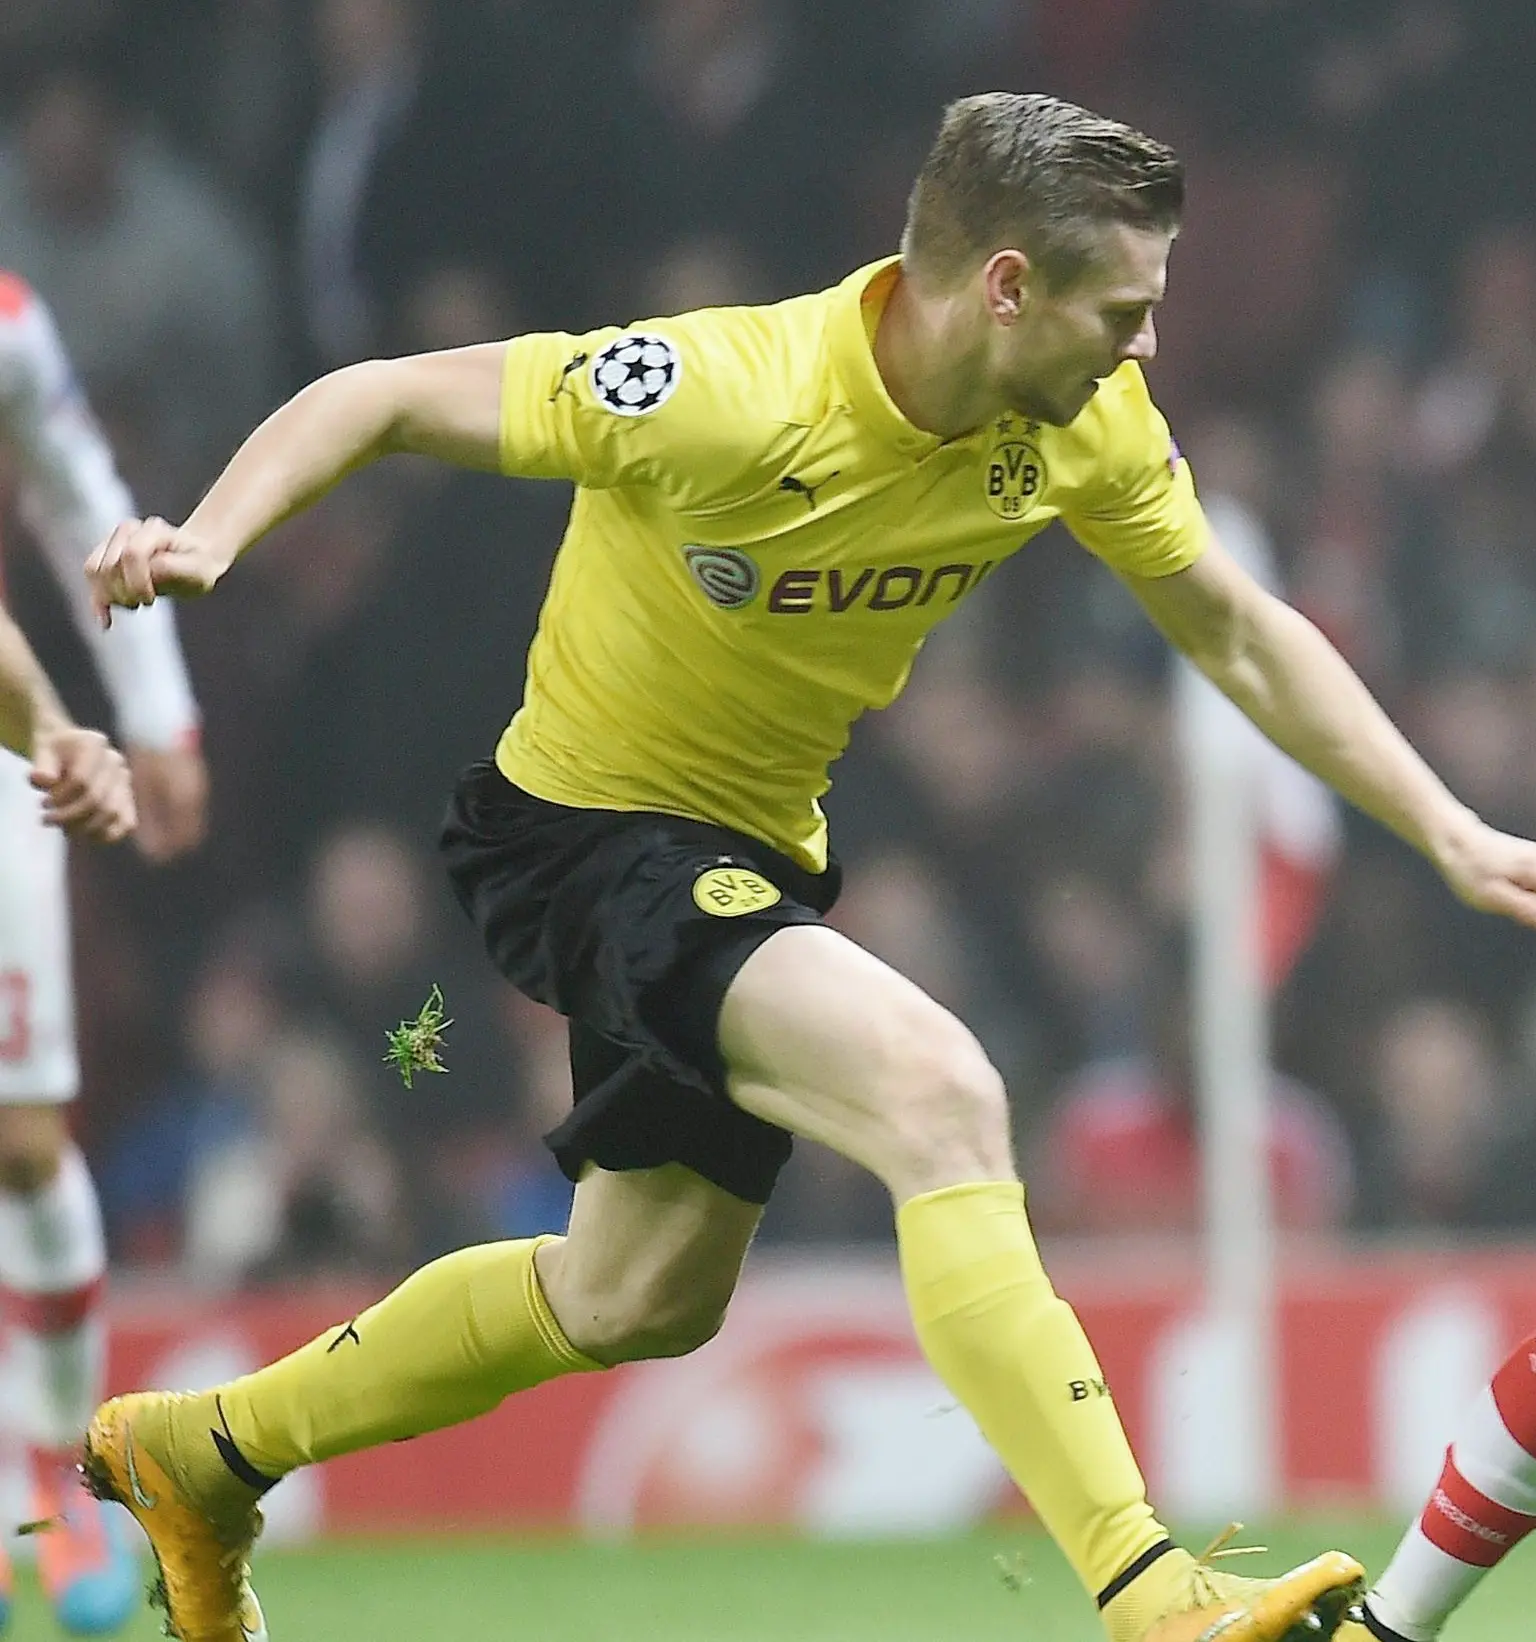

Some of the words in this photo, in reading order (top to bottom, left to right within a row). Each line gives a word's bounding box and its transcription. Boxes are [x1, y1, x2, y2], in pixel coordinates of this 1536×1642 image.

[988, 447, 1039, 496] BVB
[706, 874, 767, 906] BVB
[1068, 1377, 1111, 1401] BV
